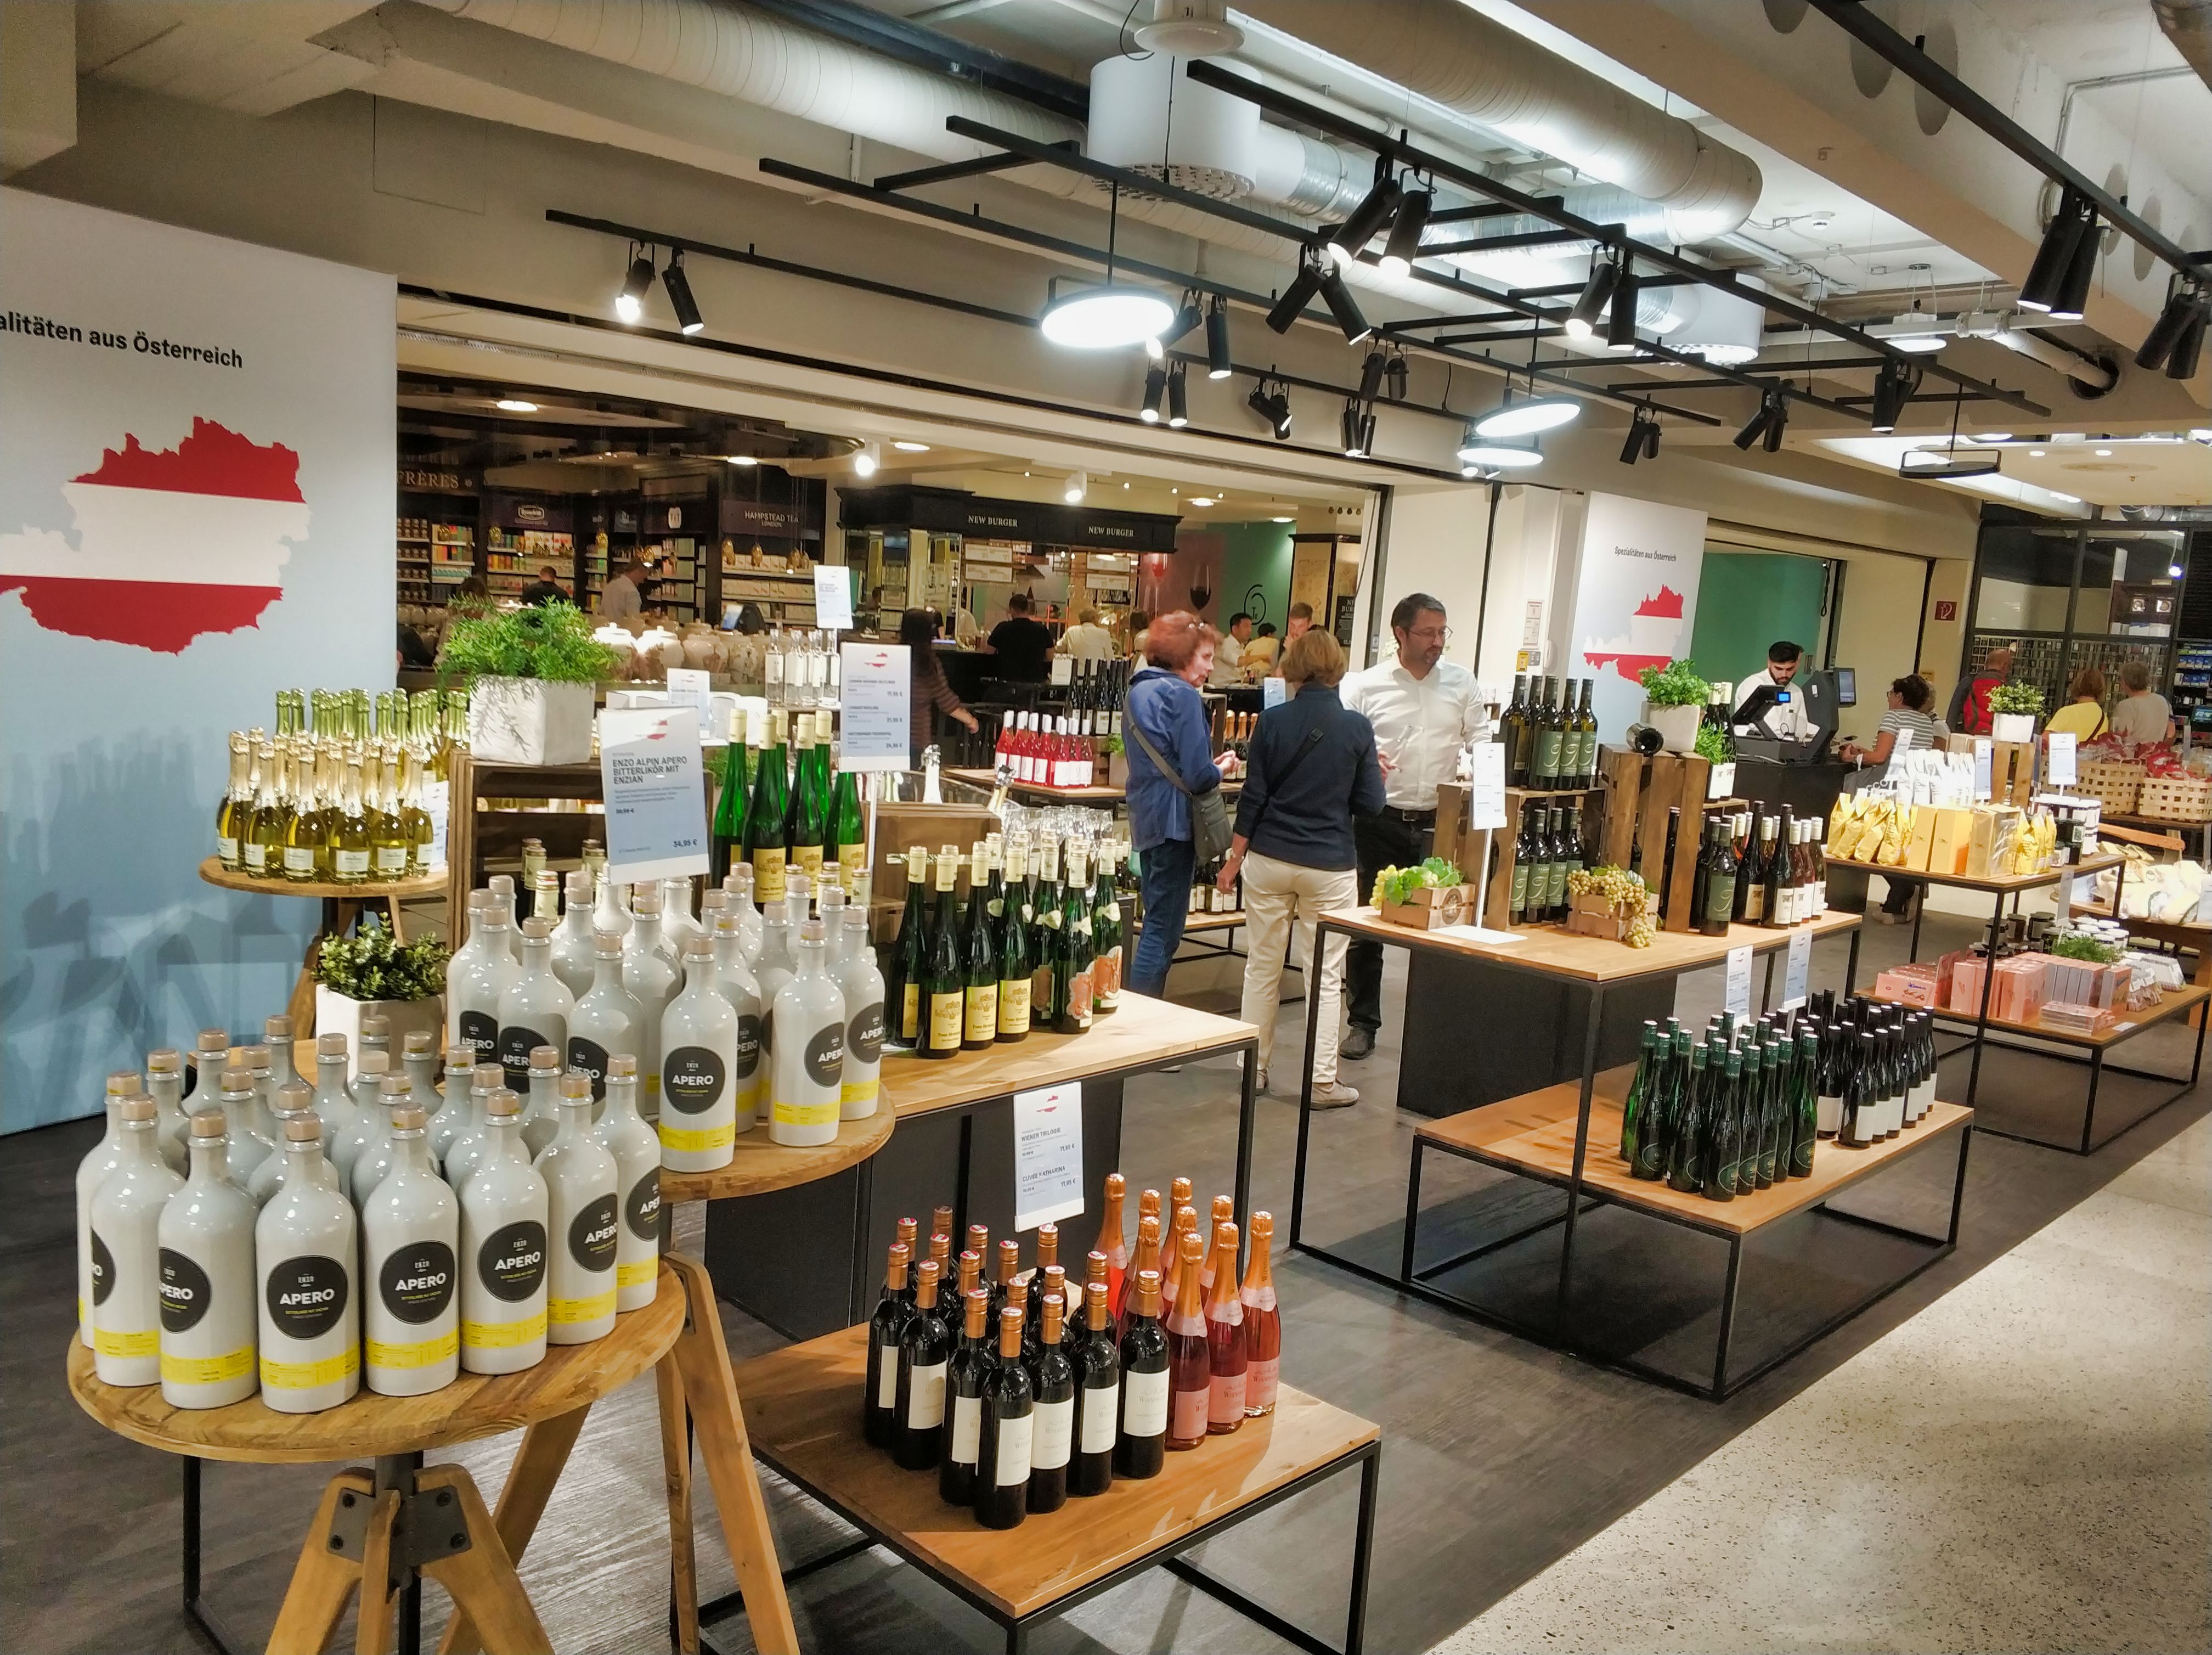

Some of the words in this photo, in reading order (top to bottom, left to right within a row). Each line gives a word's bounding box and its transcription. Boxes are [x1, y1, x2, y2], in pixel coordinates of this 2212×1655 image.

[89, 330, 127, 350] aus
[133, 331, 243, 368] Österreich
[744, 510, 786, 522] HAMPSTEAD
[787, 515, 799, 523] TEA
[761, 519, 782, 527] LONDON
[968, 515, 986, 525] NEW
[988, 516, 1018, 527] BURGER
[1088, 526, 1105, 535] NEW
[1106, 527, 1134, 537] BURGER
[1615, 546, 1644, 558] Spezialitäten
[1654, 550, 1677, 561] Österreich
[612, 758, 634, 767] ENZO
[636, 757, 659, 766] ALPIN
[662, 756, 687, 764] APERO
[614, 776, 644, 784] ENZIAN
[860, 1025, 883, 1040] APER
[737, 1040, 758, 1052] PERO
[502, 1054, 531, 1066] APER
[672, 1075, 713, 1086] APERO
[1022, 1133, 1039, 1141] WIENER
[1040, 1127, 1061, 1137] TRILOGIE
[1022, 1173, 1038, 1182] CUVÉE
[1039, 1166, 1065, 1178] KATHARINA
[494, 1251, 541, 1270] APERO
[395, 1273, 447, 1291] APERO
[159, 1282, 194, 1301] PERO
[279, 1288, 335, 1305] APERO
